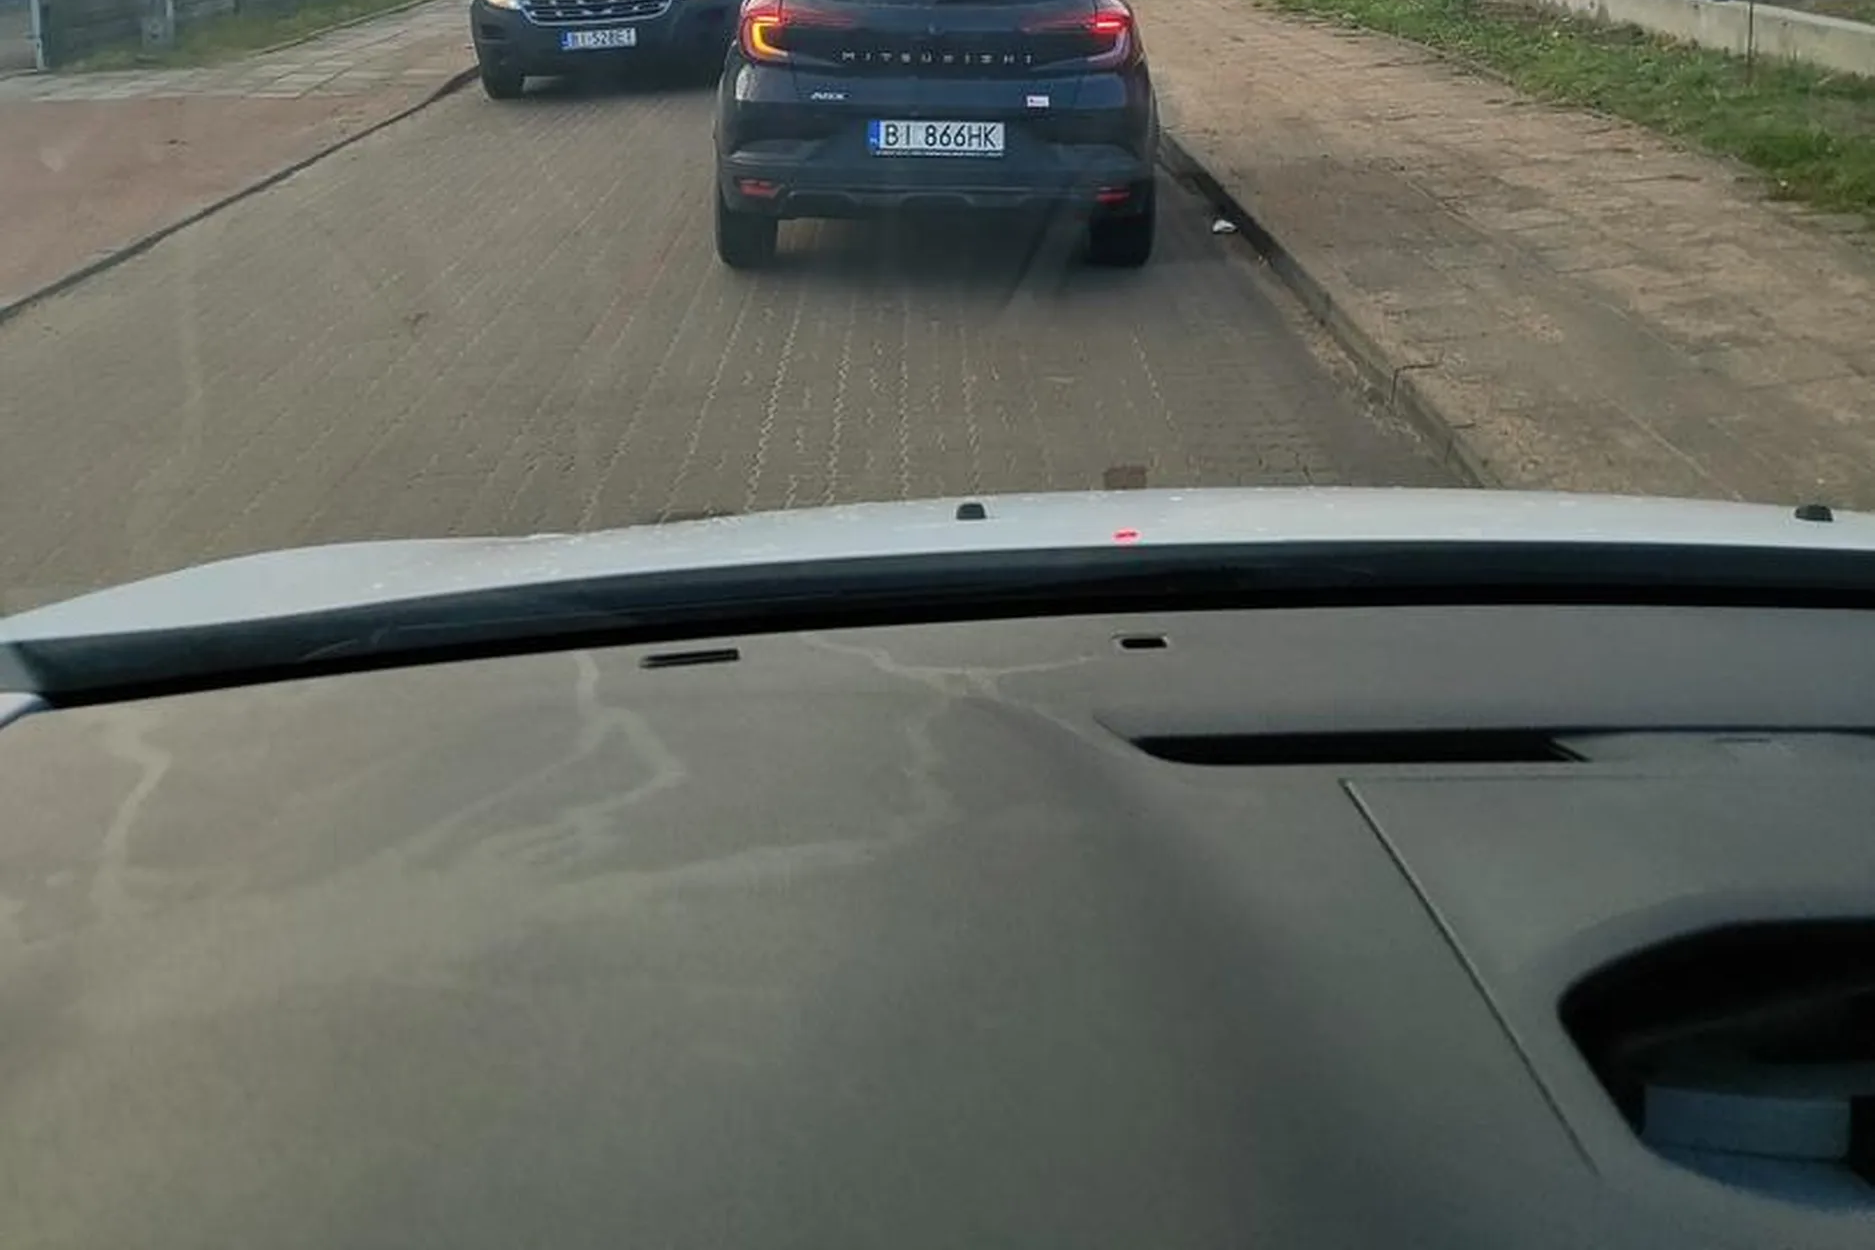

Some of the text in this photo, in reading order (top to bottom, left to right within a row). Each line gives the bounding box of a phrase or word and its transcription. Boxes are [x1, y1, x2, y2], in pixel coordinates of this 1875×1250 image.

[841, 51, 1033, 64] MITSUBISHI
[885, 124, 997, 148] BI 866HK
